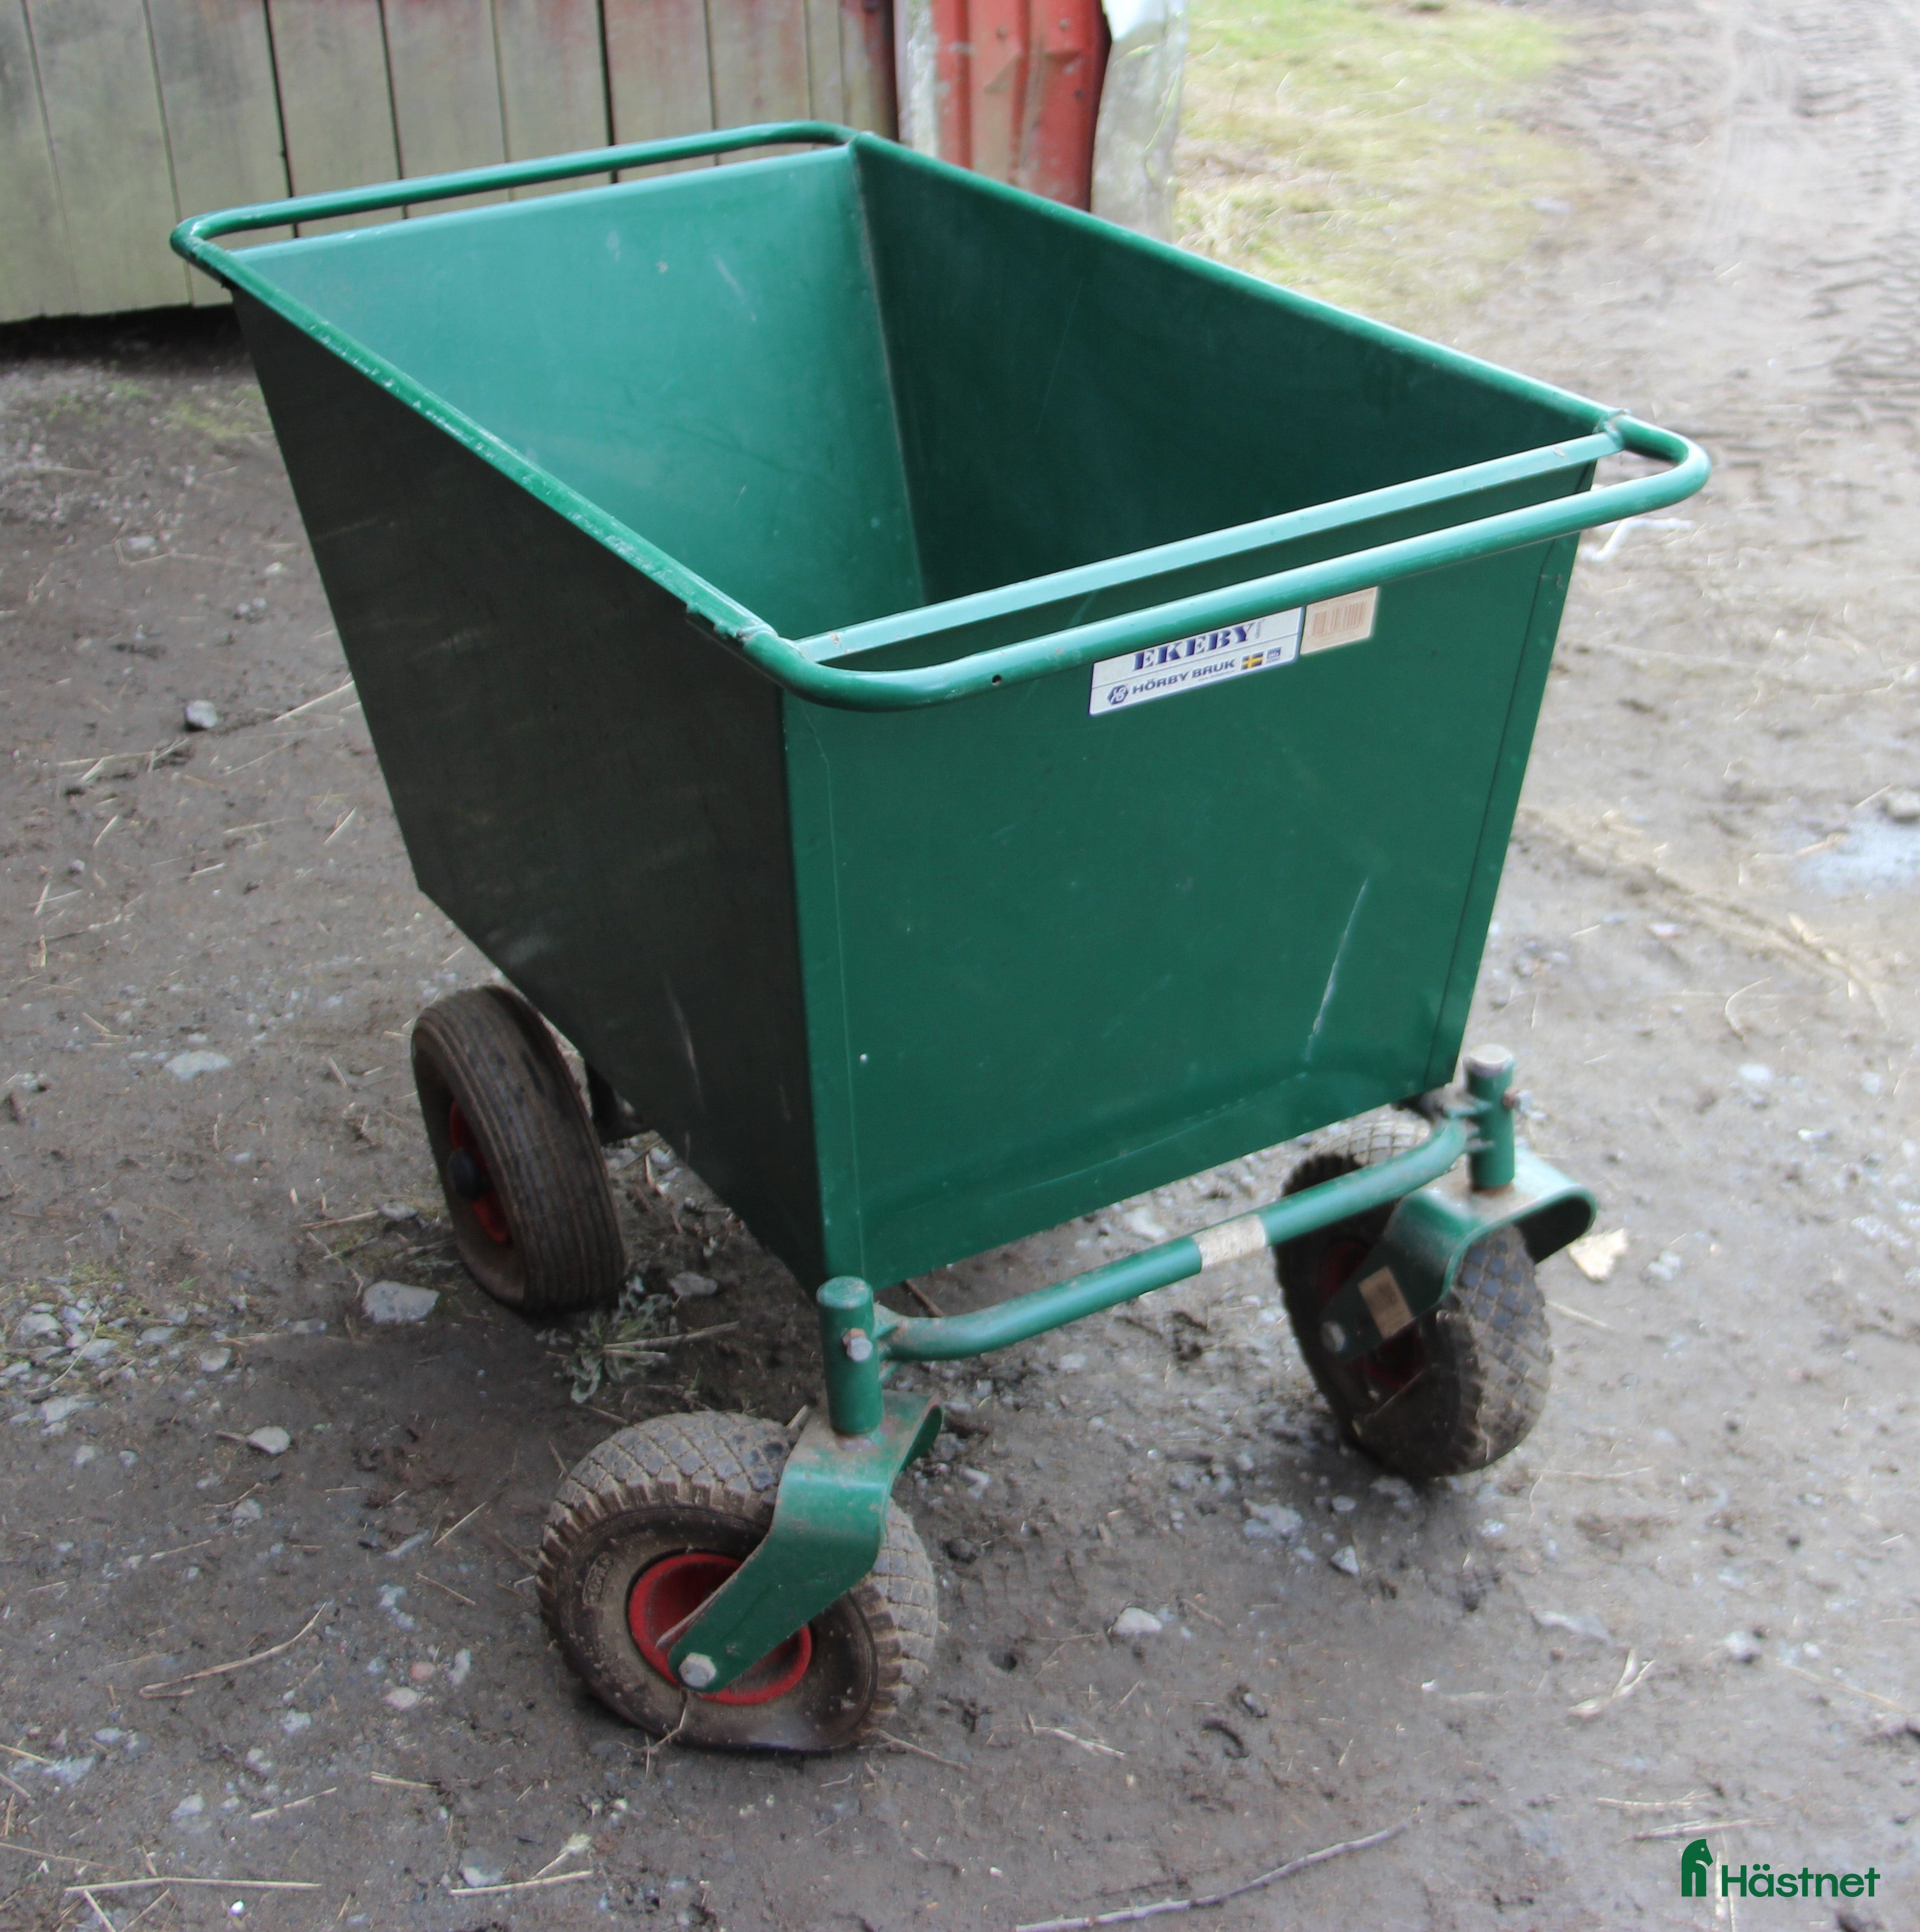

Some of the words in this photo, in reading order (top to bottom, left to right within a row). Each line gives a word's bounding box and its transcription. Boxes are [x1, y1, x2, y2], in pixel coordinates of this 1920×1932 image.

[1132, 623, 1254, 671] EKEBY
[1131, 670, 1188, 694] HÖRBY
[1191, 658, 1236, 678] BRUK
